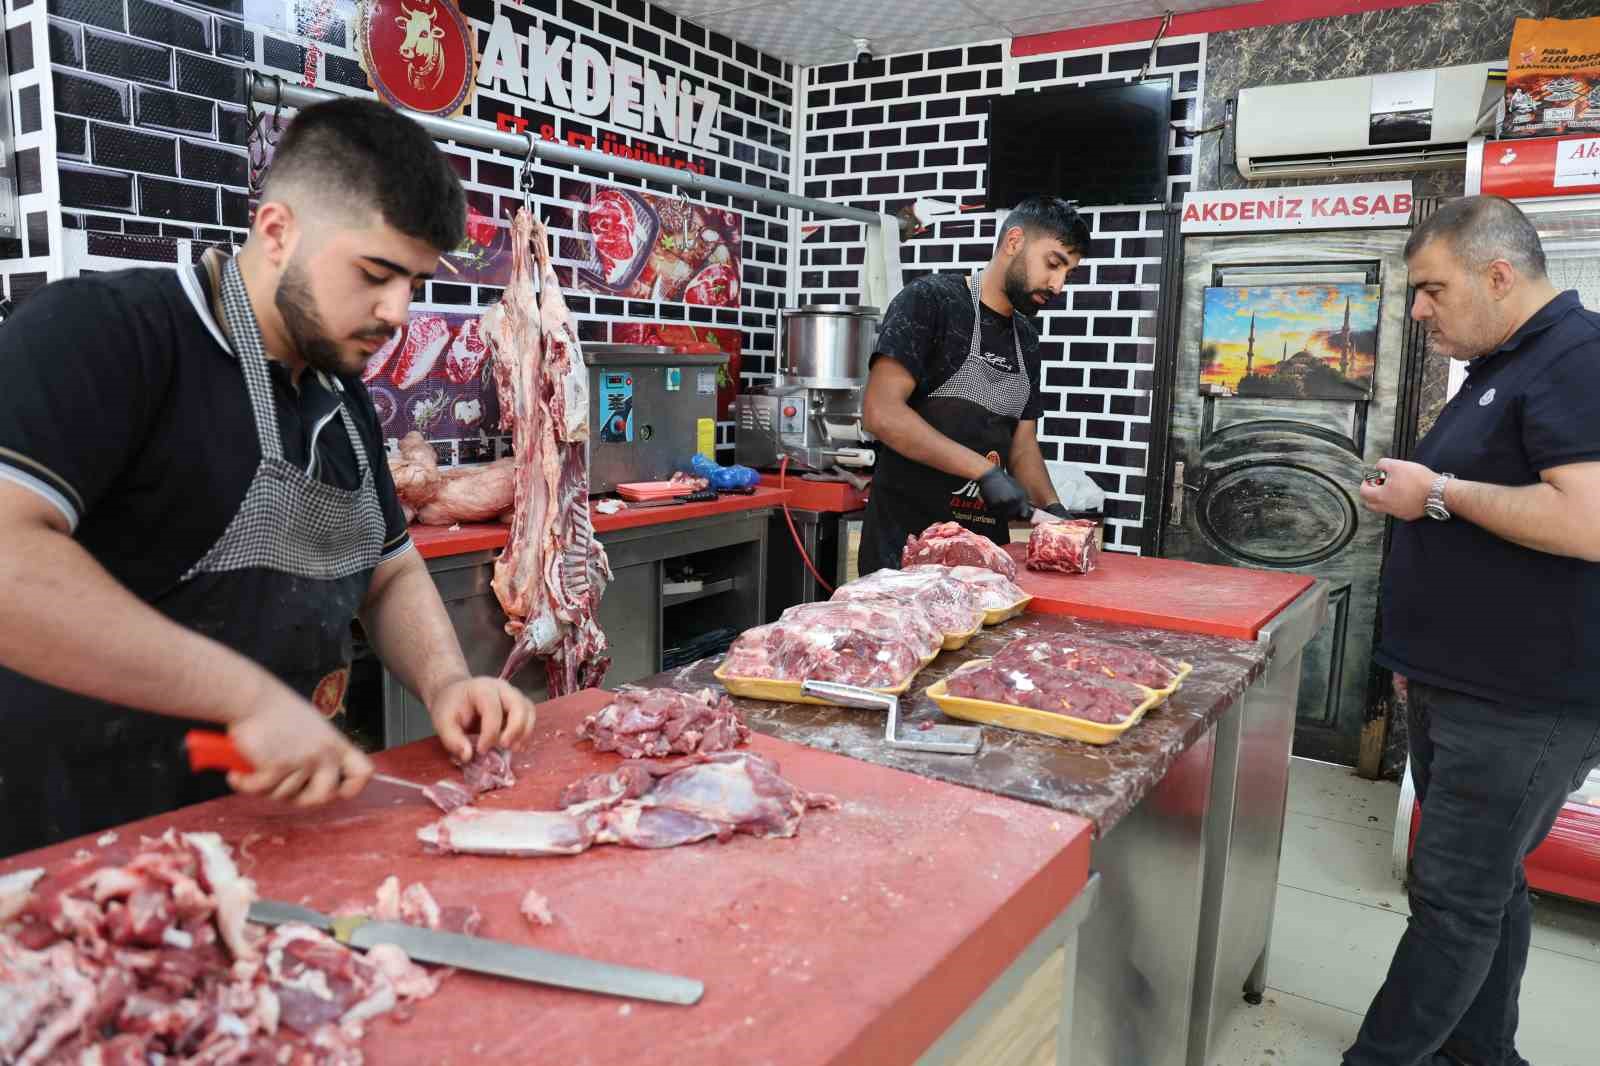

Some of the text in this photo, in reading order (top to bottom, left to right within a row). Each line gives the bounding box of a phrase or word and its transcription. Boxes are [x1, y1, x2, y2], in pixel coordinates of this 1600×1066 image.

[1568, 141, 1600, 159] Ak
[1182, 193, 1412, 222] AKDENİZ KASAB
